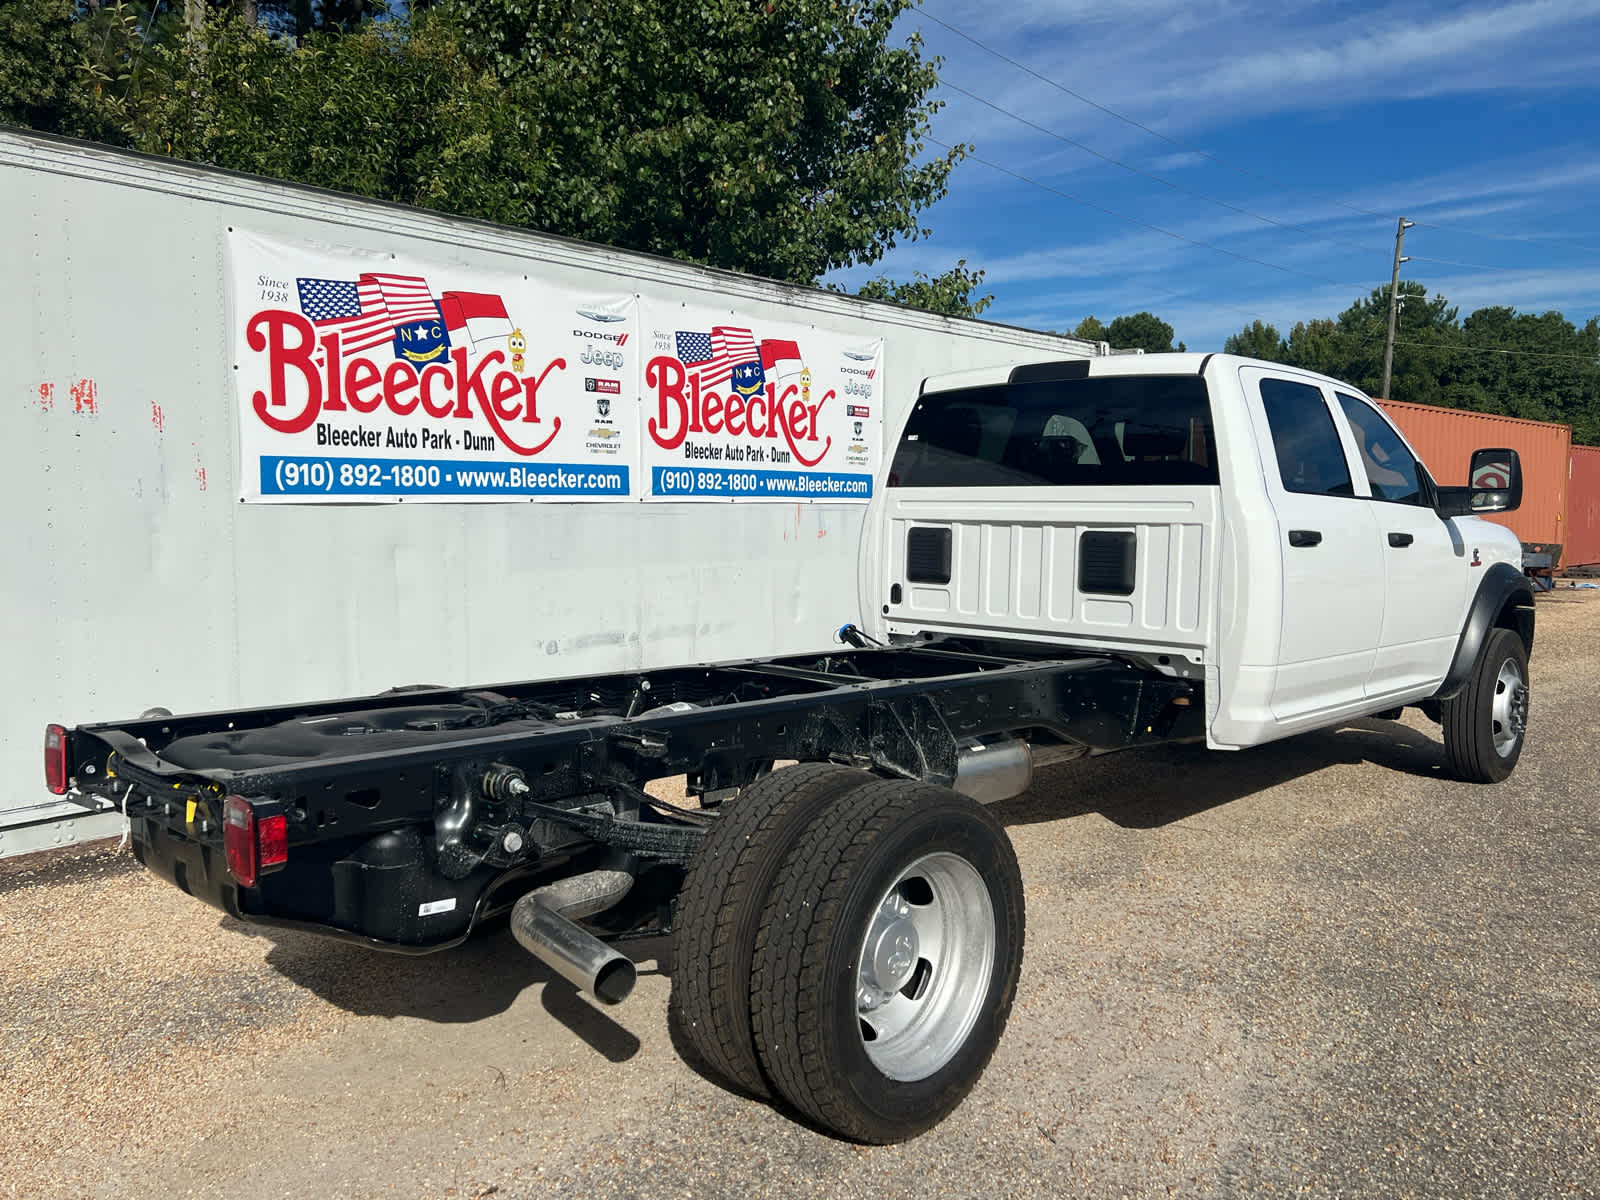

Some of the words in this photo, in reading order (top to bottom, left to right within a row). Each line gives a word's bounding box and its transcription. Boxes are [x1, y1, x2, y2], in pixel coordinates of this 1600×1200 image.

[257, 275, 289, 290] Since
[260, 289, 288, 303] 1938
[400, 327, 412, 342] N
[431, 326, 442, 339] C
[573, 330, 621, 341] DODGE
[652, 330, 671, 340] Since
[580, 345, 624, 370] Jeep
[735, 370, 743, 379] N
[753, 367, 761, 376] C
[840, 367, 870, 375] DODGE
[246, 309, 567, 456] Bleecker
[844, 378, 872, 399] Jeep
[646, 355, 836, 467] Bleecker
[316, 423, 382, 448] Bleecker
[386, 426, 418, 449] Auto
[421, 428, 452, 450] Park
[463, 432, 495, 451] Dunn
[684, 441, 723, 462] Bleecker
[725, 444, 744, 462] Auto
[746, 446, 765, 462] Park
[771, 446, 791, 463] Dunn
[275, 460, 334, 490] (910)
[340, 464, 441, 488] 892-1800
[456, 467, 621, 489] www.Bleecker.com
[660, 469, 694, 492] (910)
[697, 472, 757, 491] 892-1800
[766, 476, 868, 493] www.Bleecker.com
